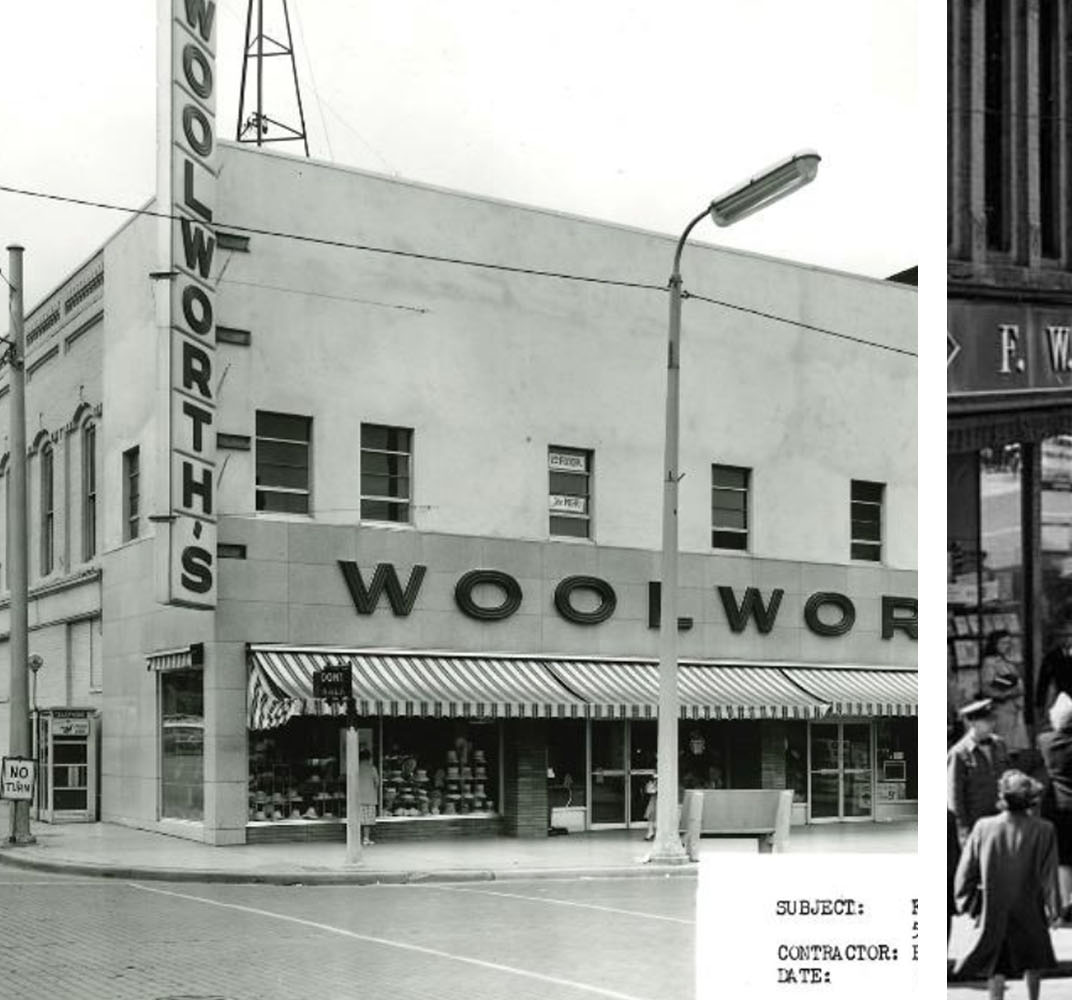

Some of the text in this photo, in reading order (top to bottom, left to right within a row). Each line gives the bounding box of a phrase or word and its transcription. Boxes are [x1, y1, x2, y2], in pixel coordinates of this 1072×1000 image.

[998, 324, 1025, 373] F.
[10, 766, 29, 779] NO
[776, 899, 865, 916] SUBJECT:
[777, 944, 899, 961] CONTRACTOR:
[777, 968, 832, 983] DATE:
